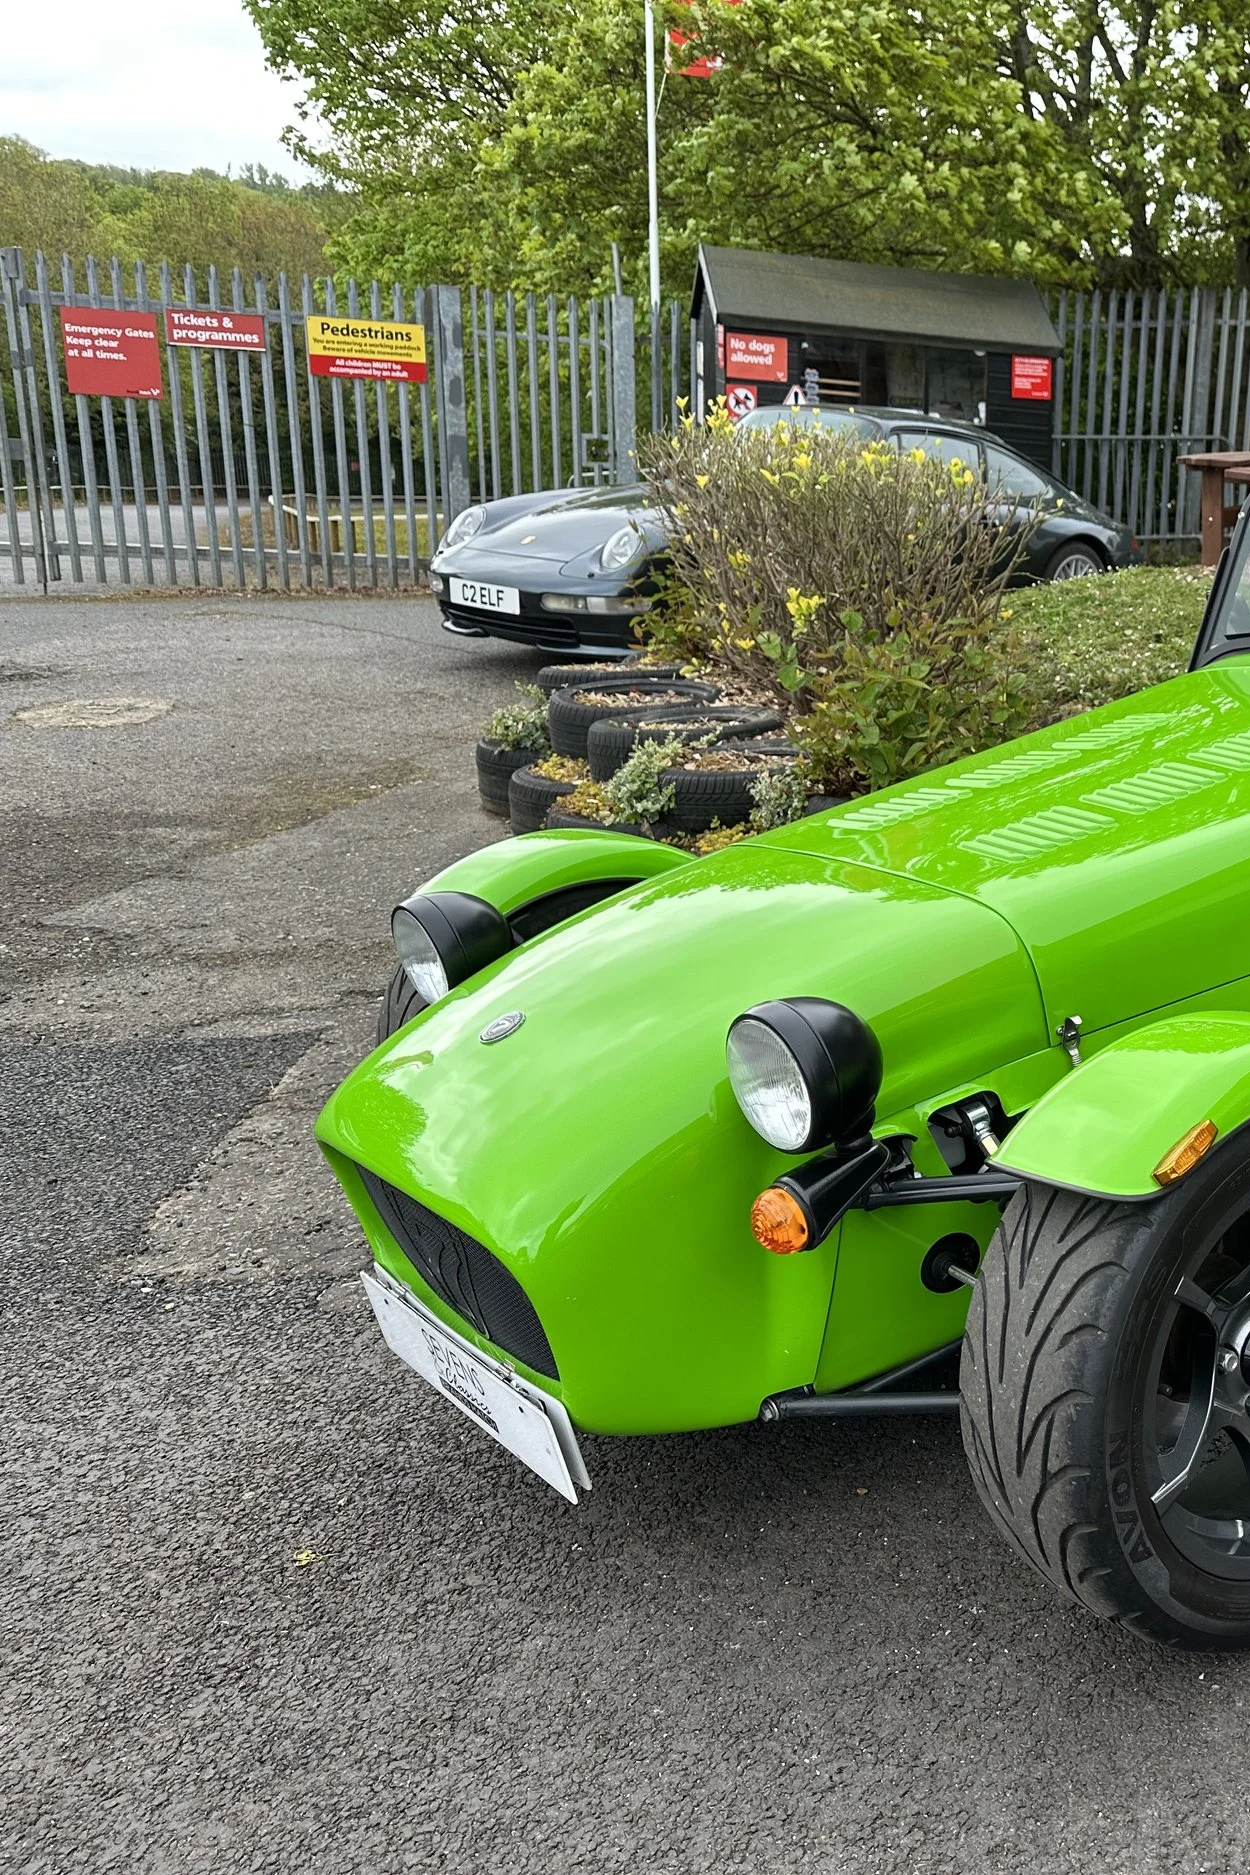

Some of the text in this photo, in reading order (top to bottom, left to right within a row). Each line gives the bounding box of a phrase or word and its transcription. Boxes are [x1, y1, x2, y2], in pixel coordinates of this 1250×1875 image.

[171, 312, 233, 329] Tickets &
[64, 323, 155, 339] Emergency Gates
[172, 328, 260, 343] programmes
[320, 321, 413, 342] Pedestrians
[65, 335, 119, 348] Keep clear
[336, 339, 363, 348] entering
[368, 342, 394, 351] working
[394, 344, 421, 352] paddock
[730, 338, 776, 355] No dogs
[67, 348, 127, 361] at all times.
[322, 345, 346, 353] Beware
[354, 347, 376, 355] vehicle
[730, 350, 773, 365] allowed
[335, 358, 345, 366] All
[345, 359, 371, 368] children
[372, 361, 392, 370] MUST
[329, 366, 372, 376] accompanied
[372, 368, 382, 378] by
[391, 370, 408, 379] adult
[461, 583, 505, 608] C2 ELF
[421, 1328, 485, 1396] SEVENS
[1108, 1427, 1154, 1564] AVON
